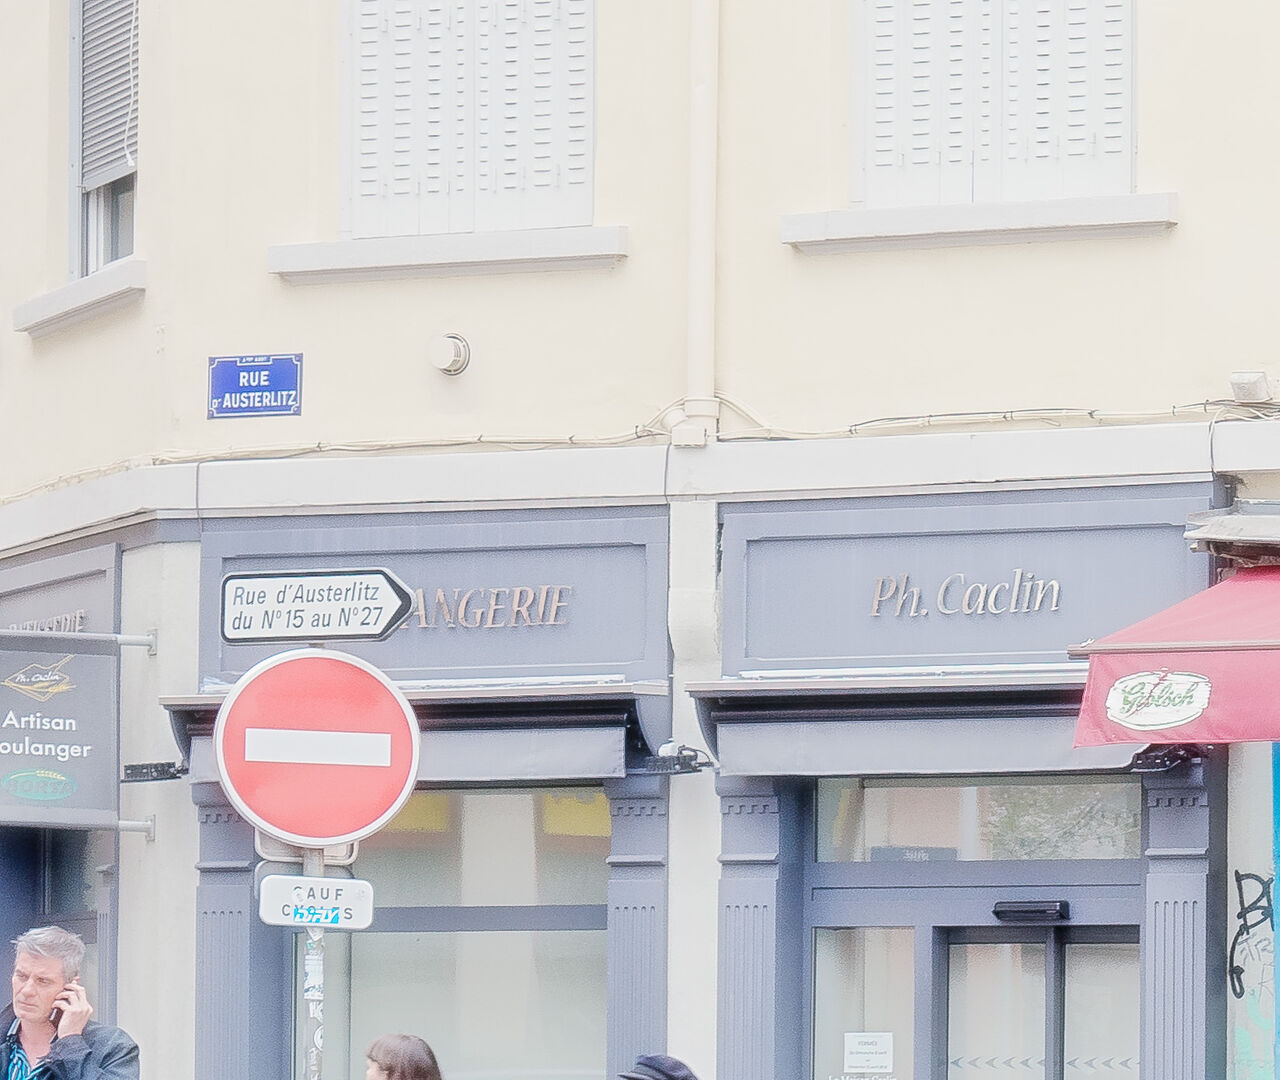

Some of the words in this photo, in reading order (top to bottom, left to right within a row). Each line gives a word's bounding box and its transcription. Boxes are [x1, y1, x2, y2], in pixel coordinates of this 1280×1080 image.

[239, 370, 270, 387] RUE
[232, 586, 267, 605] Rue
[276, 582, 380, 604] d'Austerlitz
[870, 573, 929, 616] Ph.
[936, 568, 1060, 615] Caclin
[232, 611, 253, 630] du
[311, 613, 331, 627] au
[2, 710, 77, 731] Artisan
[0, 737, 92, 762] oulanger
